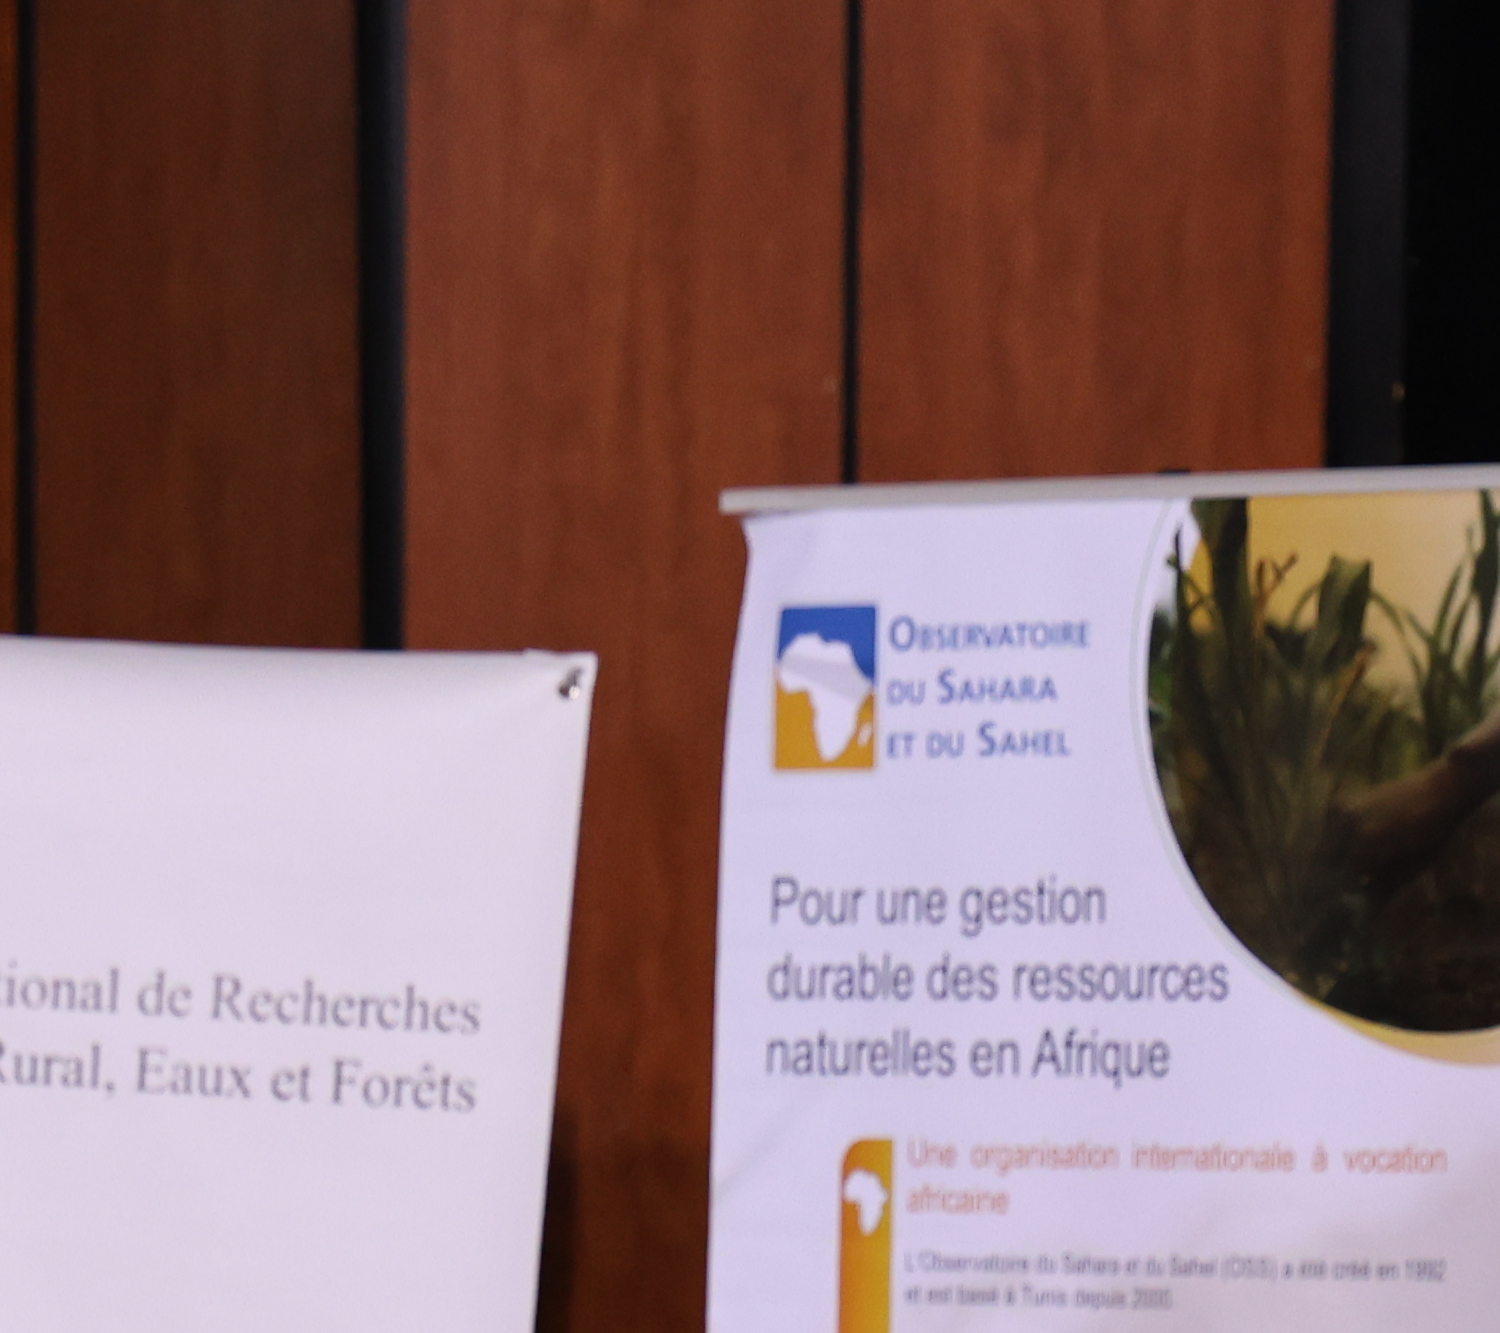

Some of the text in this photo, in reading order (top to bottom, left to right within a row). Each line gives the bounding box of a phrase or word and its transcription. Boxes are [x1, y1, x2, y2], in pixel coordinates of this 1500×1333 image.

[769, 873, 1107, 938] Pour une gestion
[137, 971, 194, 1019] de
[210, 974, 483, 1036] Recherches
[766, 952, 1231, 1003] durable des ressources
[136, 1047, 253, 1102] Eaux
[271, 1060, 312, 1105] et
[330, 1057, 479, 1113] Forêts
[765, 1028, 1171, 1091] naturelles en Afrique
